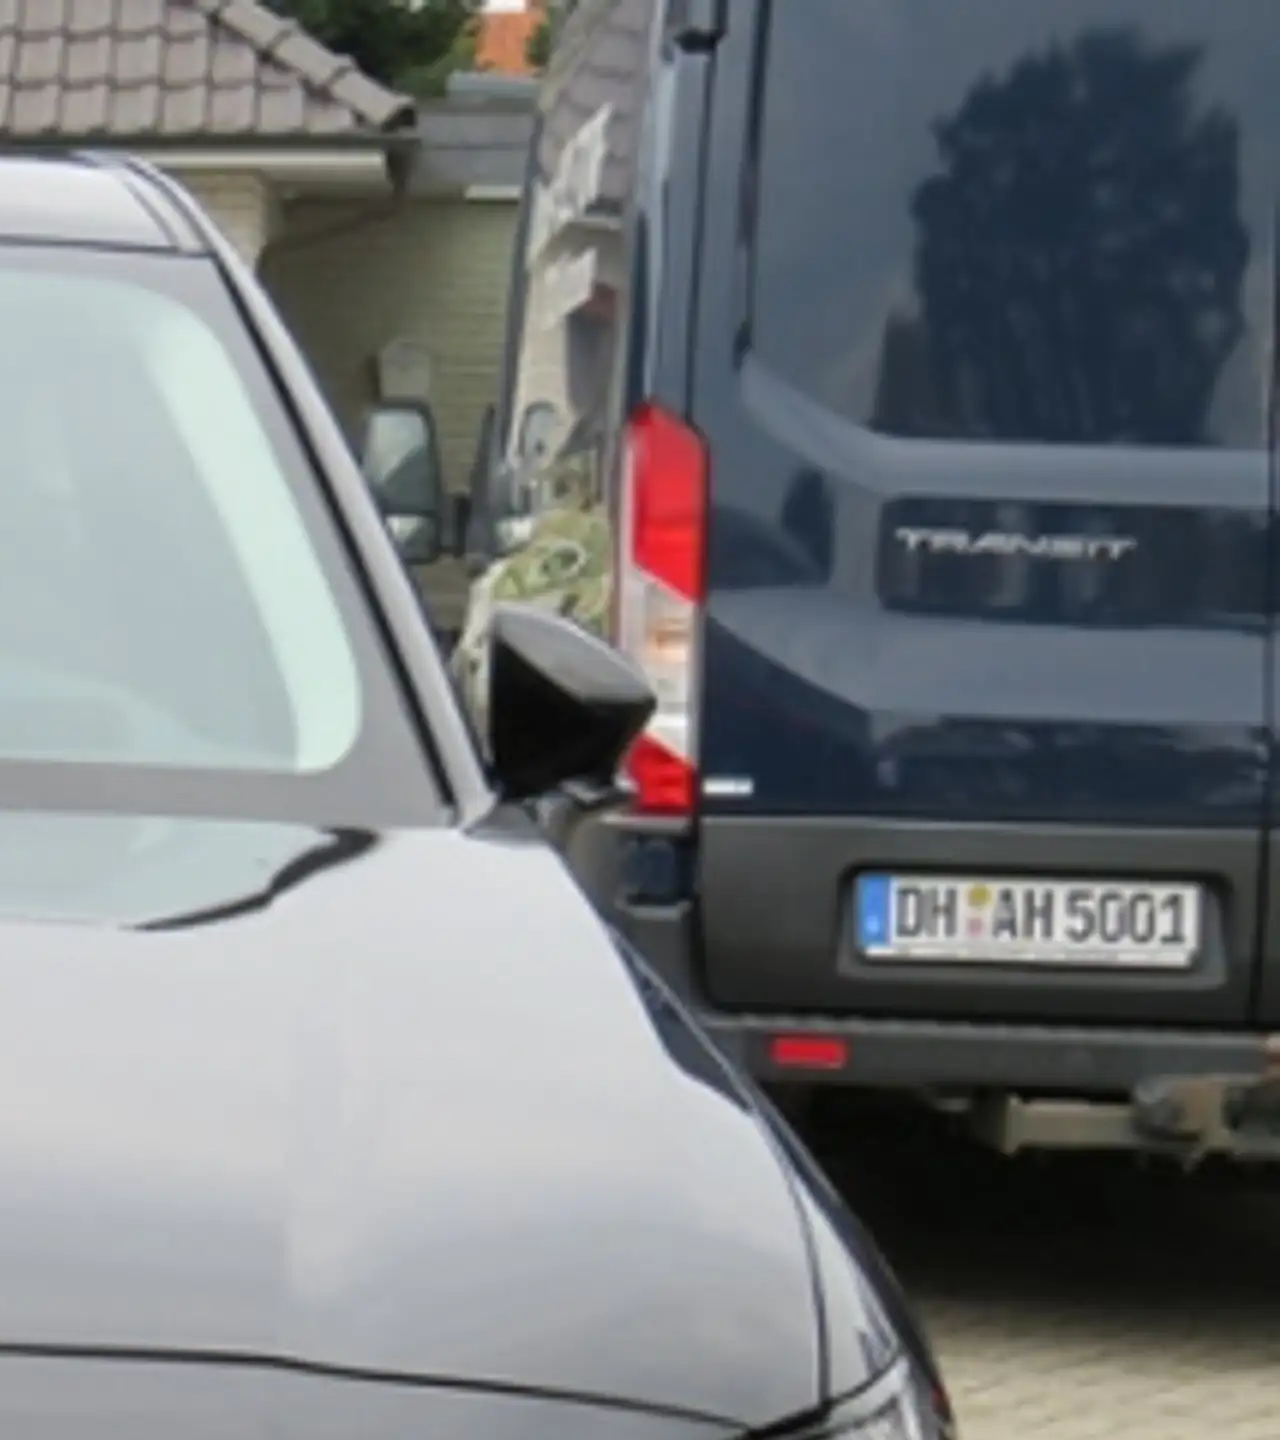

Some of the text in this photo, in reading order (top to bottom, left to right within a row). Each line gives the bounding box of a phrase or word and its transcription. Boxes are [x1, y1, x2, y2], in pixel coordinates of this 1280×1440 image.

[894, 527, 1138, 560] TRANSIT
[896, 887, 1186, 943] DH AH 5001
